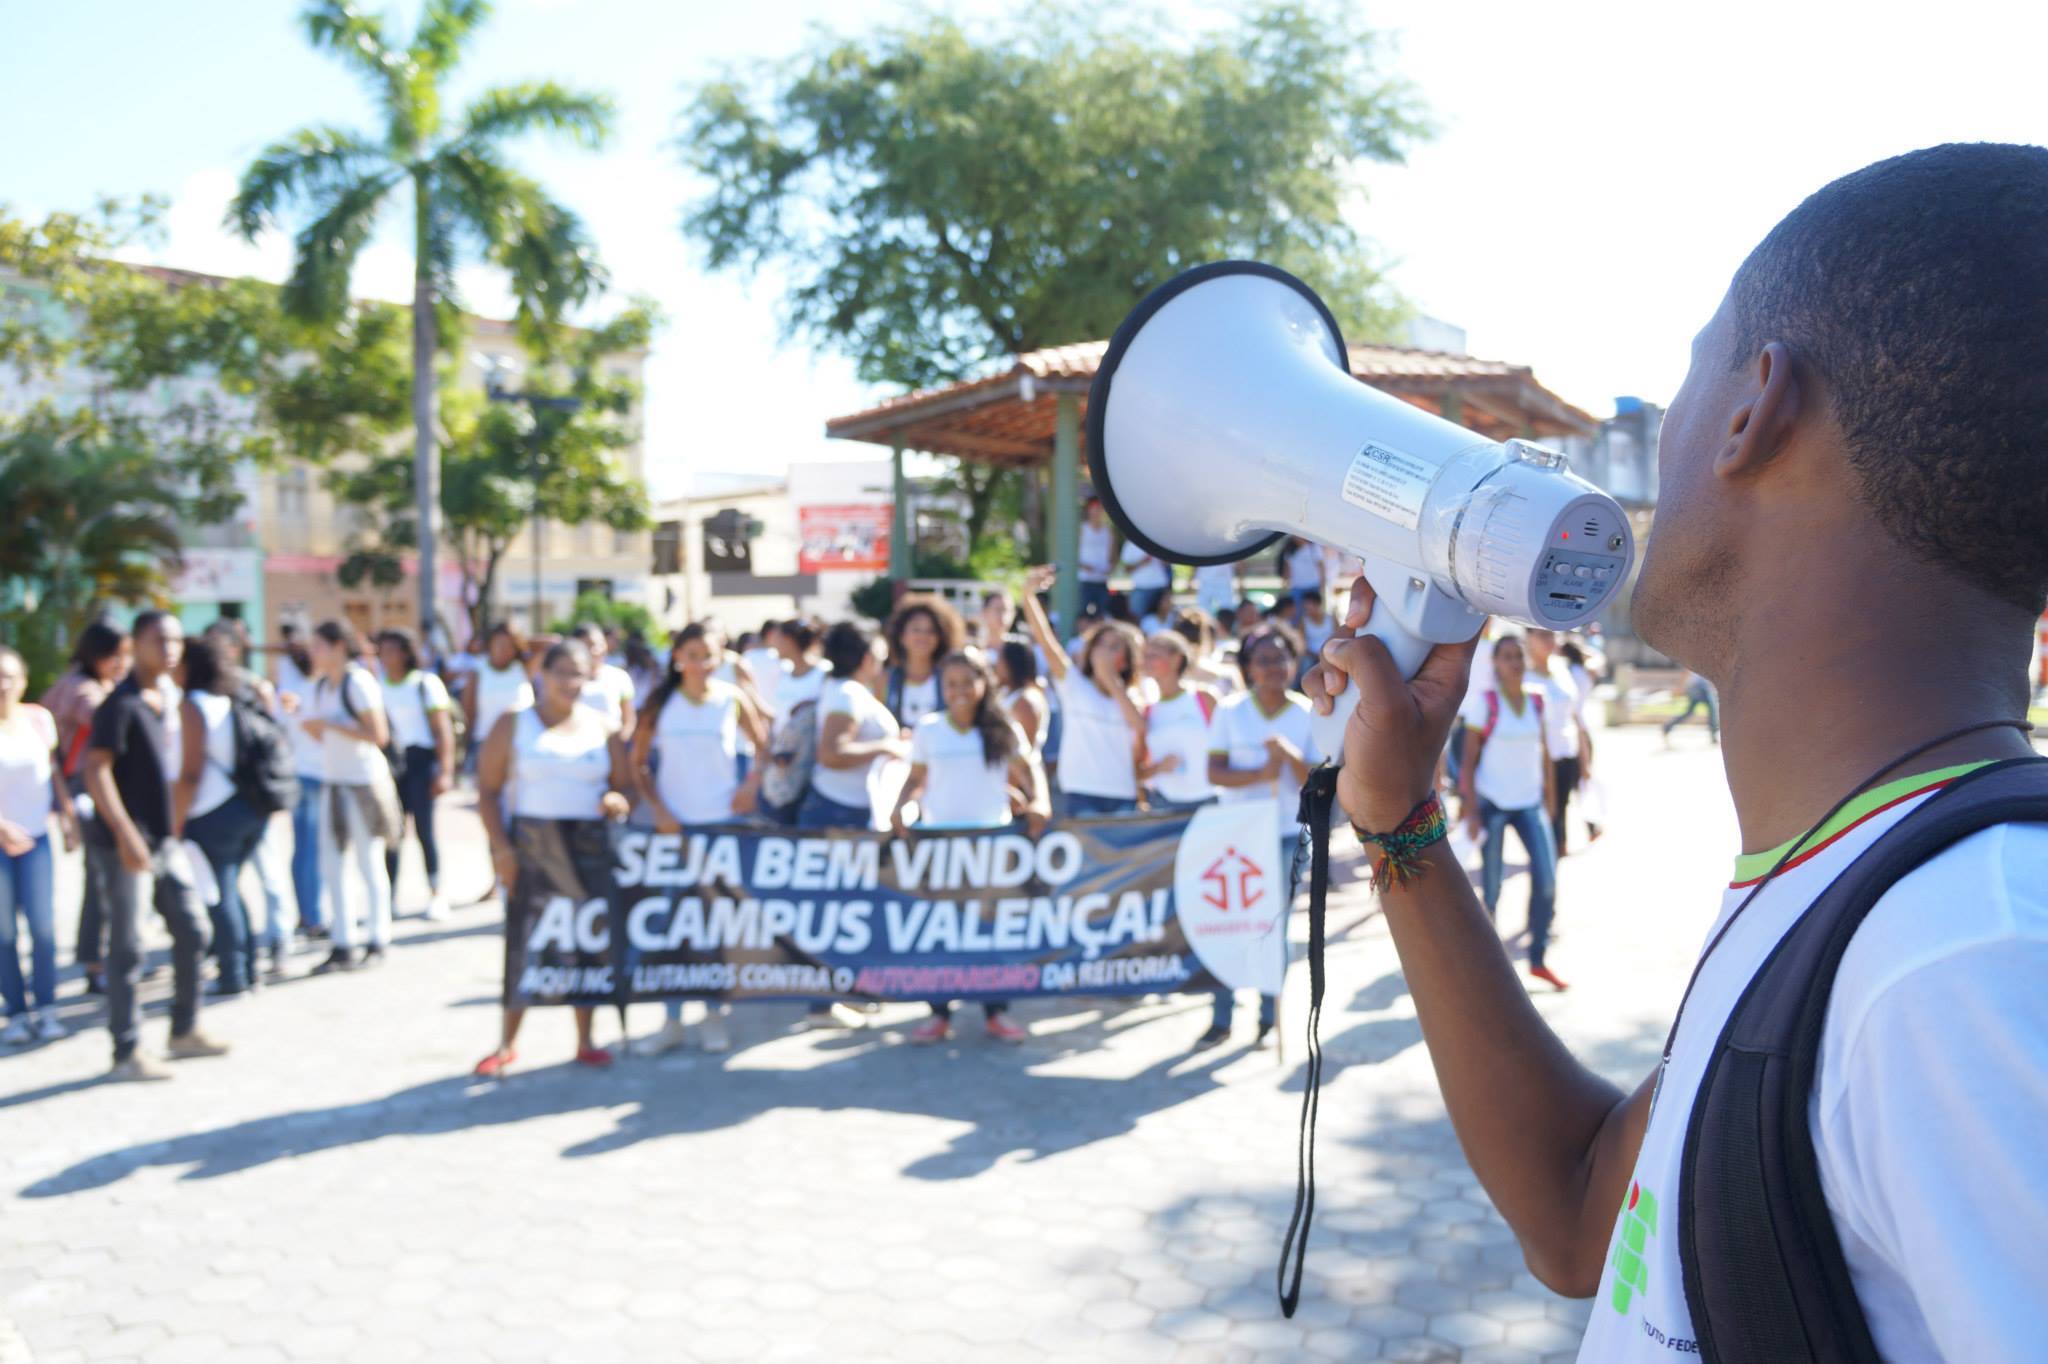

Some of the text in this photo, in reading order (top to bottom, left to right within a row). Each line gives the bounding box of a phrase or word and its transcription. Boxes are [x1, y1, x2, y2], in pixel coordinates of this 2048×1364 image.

[615, 831, 1083, 891] SEJA BEM VINDO
[626, 896, 873, 955] CAMPUS
[885, 888, 1169, 958] VALENÇA!
[632, 962, 737, 992] LUTAMOS
[739, 963, 832, 992] CONTRA
[833, 966, 855, 993] O
[1042, 962, 1076, 990] DA
[1642, 1316, 1699, 1354] TUTO FEDE
